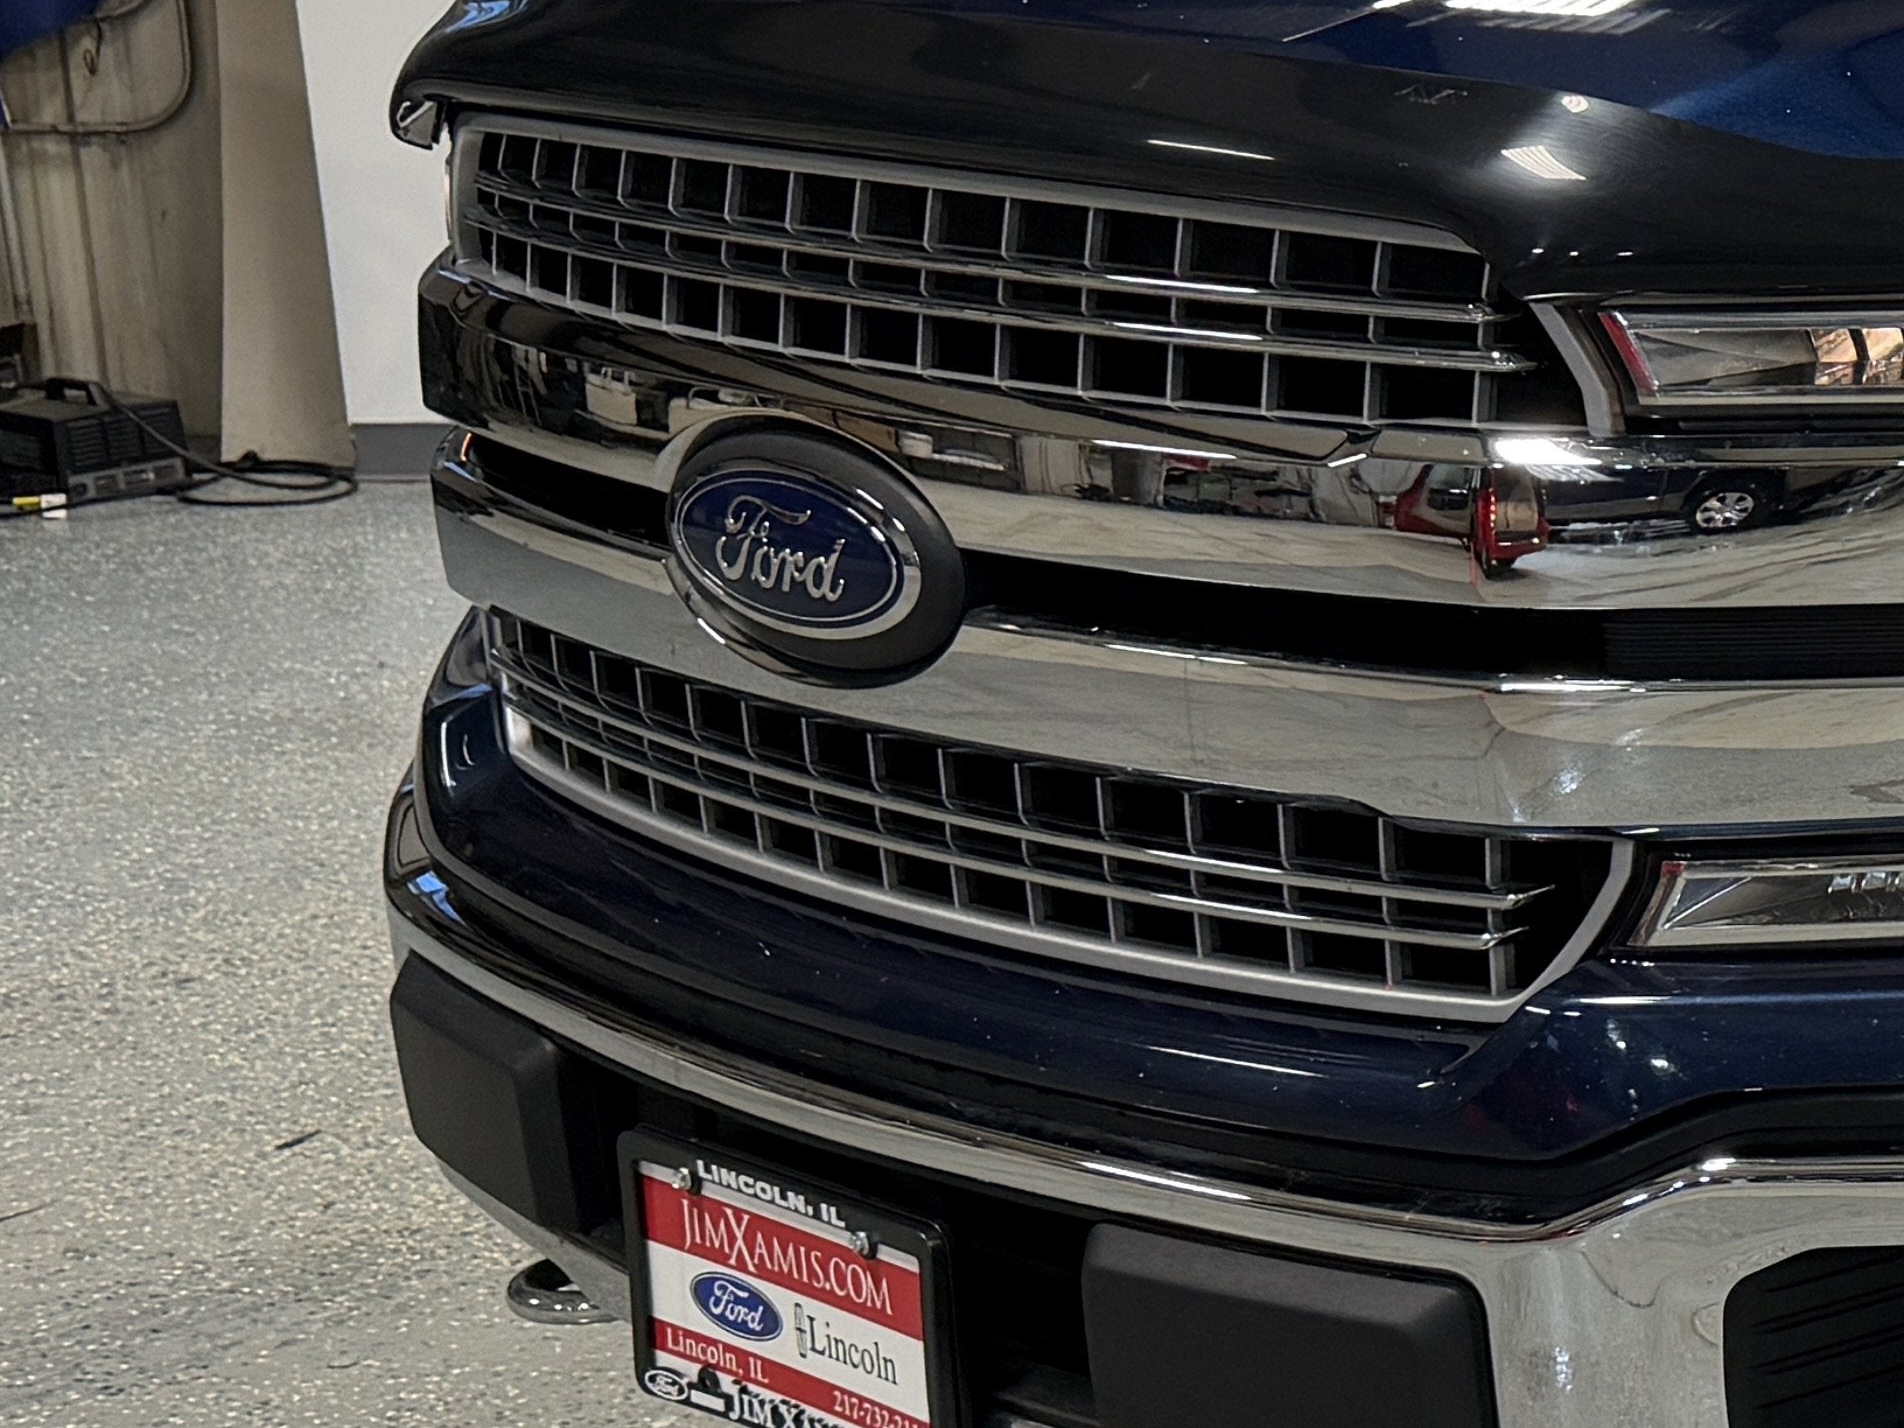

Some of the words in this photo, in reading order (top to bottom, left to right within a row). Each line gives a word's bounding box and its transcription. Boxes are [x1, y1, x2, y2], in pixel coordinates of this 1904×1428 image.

[715, 494, 846, 602] Ford
[696, 1159, 815, 1217] LINCOLN,
[820, 1202, 847, 1228] IL
[708, 1279, 764, 1333] Ford
[666, 1327, 744, 1376] Lincoln,
[749, 1356, 770, 1384] IL
[806, 1313, 898, 1386] Lincoln
